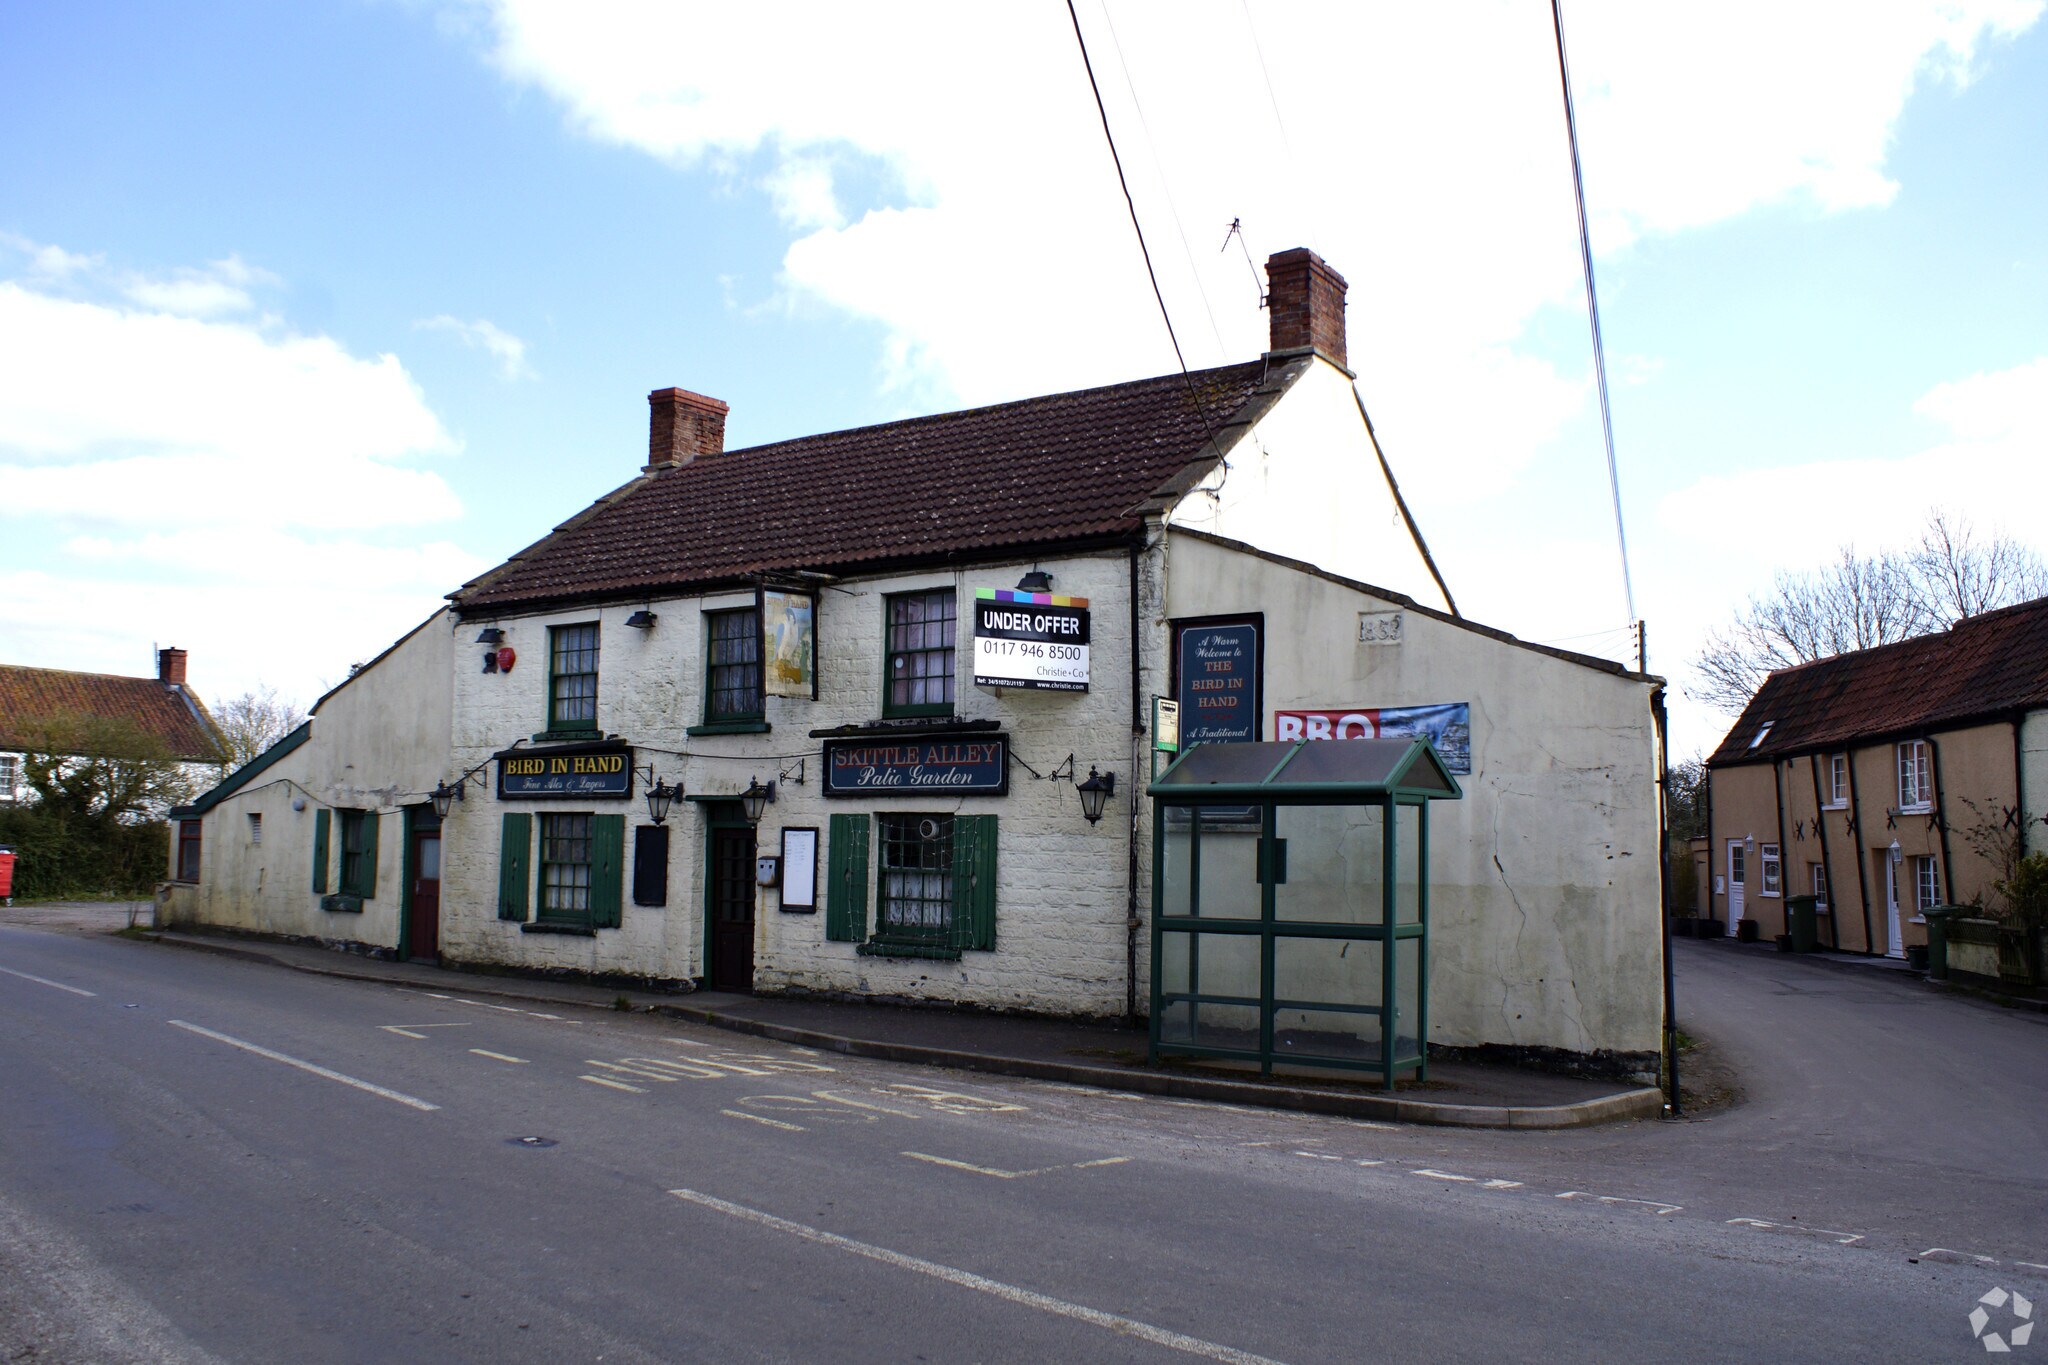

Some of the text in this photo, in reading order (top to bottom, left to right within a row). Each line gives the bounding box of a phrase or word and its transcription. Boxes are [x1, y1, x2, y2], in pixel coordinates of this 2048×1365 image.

[984, 610, 1080, 635] UNDER OFFER
[1198, 635, 1239, 647] A Warm
[984, 640, 1081, 661] 0117 946 8500
[1195, 647, 1242, 658] Welcome to
[1204, 660, 1232, 672] THE
[1037, 682, 1085, 691] www.christie.com
[1192, 678, 1243, 691] BIRD IN
[1198, 696, 1239, 709] HAND
[1186, 727, 1249, 738] A Traditional
[835, 743, 998, 767] SKITTLE ALLEY
[506, 756, 623, 775] BIRD IN HAND
[857, 764, 973, 786] Patio Garden
[522, 777, 541, 790] Fine
[544, 777, 563, 789] Ales
[579, 776, 606, 792] Lagers
